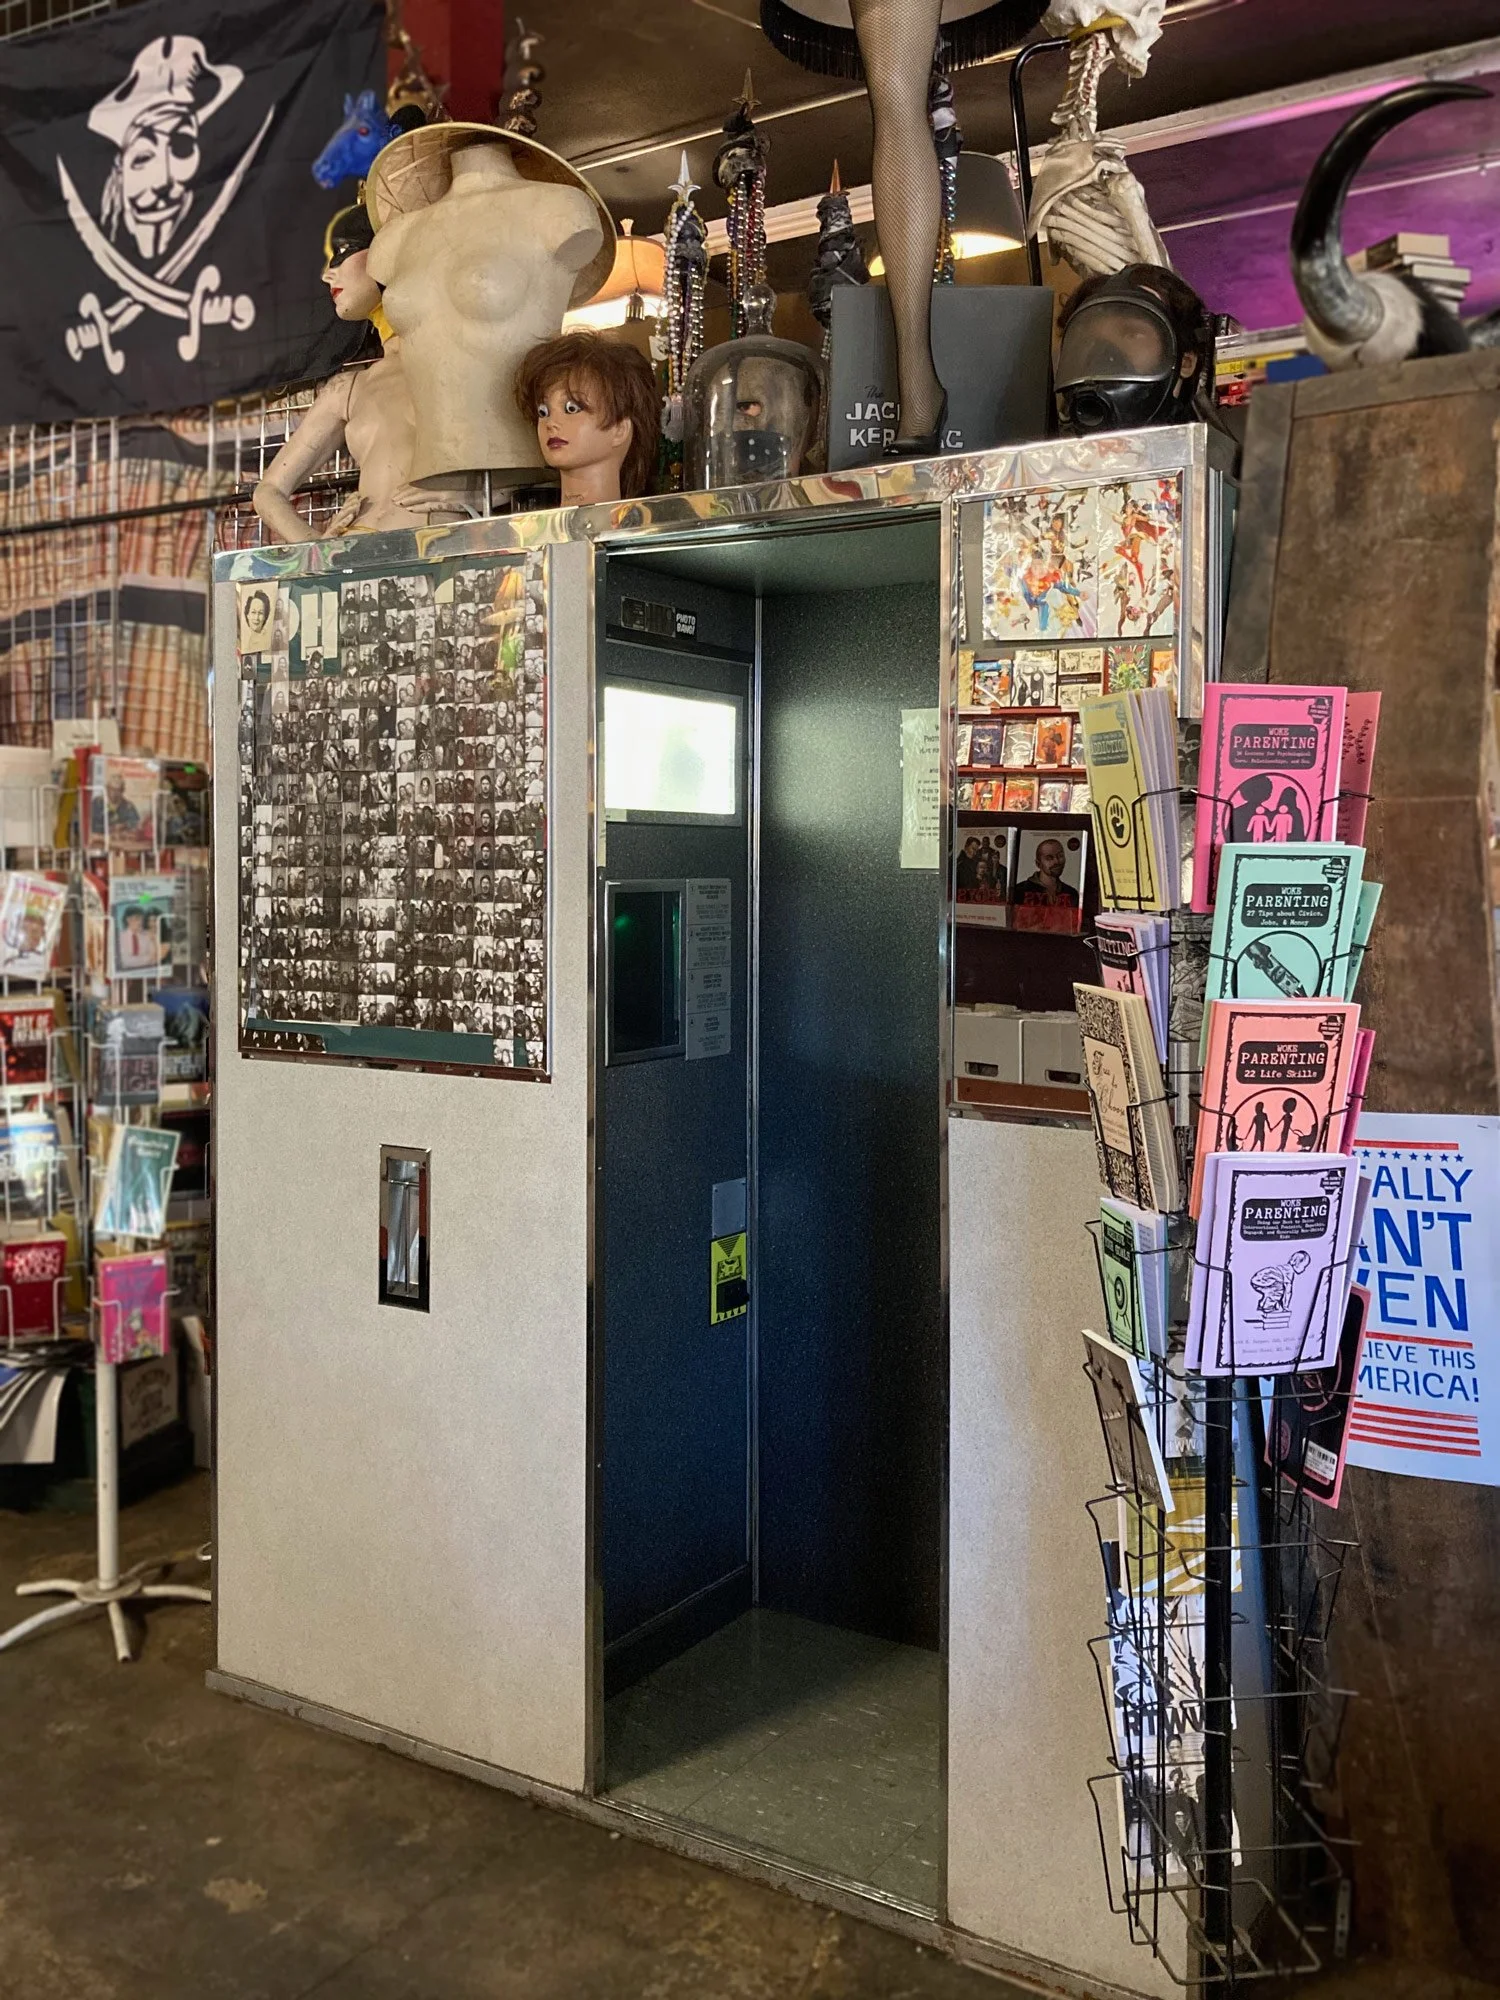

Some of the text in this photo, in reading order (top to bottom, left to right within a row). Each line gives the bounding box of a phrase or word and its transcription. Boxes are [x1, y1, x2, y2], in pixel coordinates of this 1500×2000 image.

[846, 402, 900, 421] JAC
[849, 428, 964, 449] KERC
[676, 613, 696, 625] PHOTO
[1269, 727, 1290, 736] WOKE
[1233, 736, 1316, 749] PARENTING
[1281, 887, 1302, 895] WOKE
[1245, 895, 1329, 908] PARENTING
[1277, 1044, 1298, 1053] WOKE
[1240, 1052, 1325, 1065] PARENTING
[1244, 1070, 1317, 1078] 22 Life Skills
[1359, 1165, 1473, 1202] ALLY
[1280, 1199, 1302, 1207] WOKE
[1244, 1205, 1327, 1220] PARENTING
[1428, 1347, 1476, 1370] THIS
